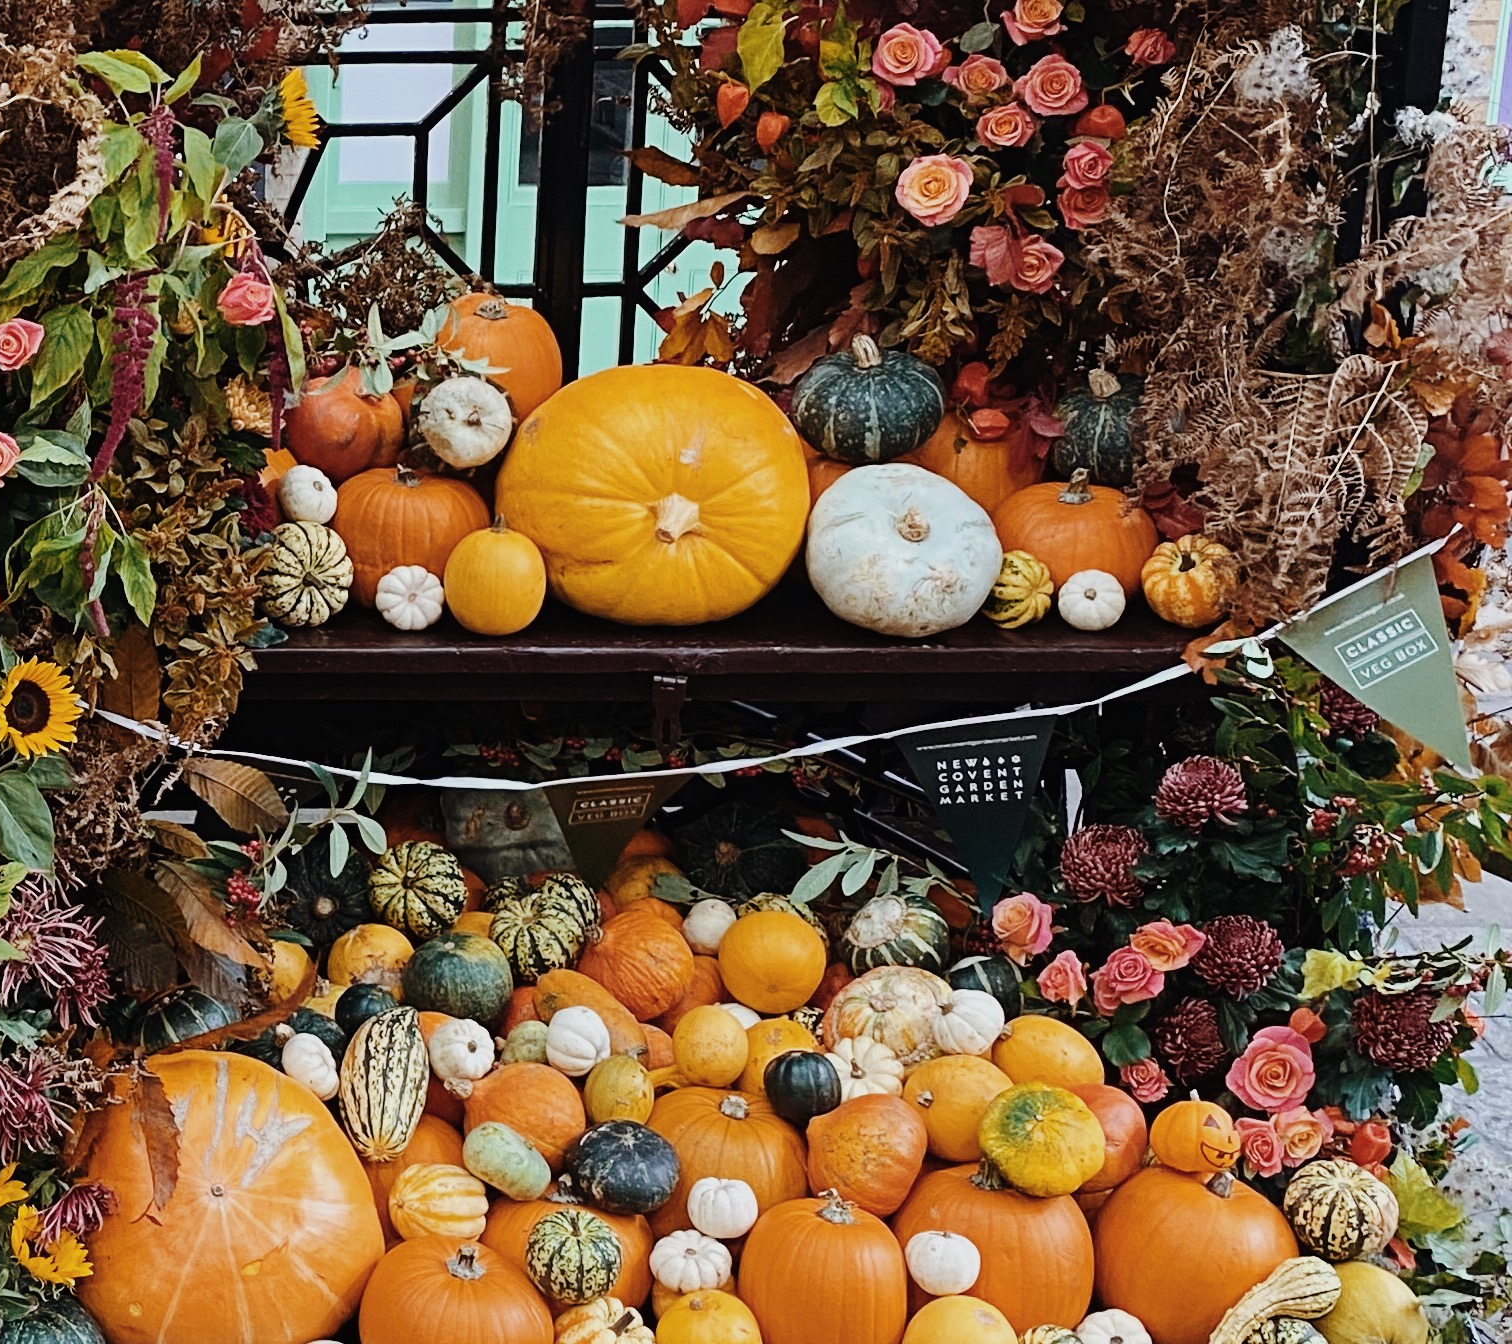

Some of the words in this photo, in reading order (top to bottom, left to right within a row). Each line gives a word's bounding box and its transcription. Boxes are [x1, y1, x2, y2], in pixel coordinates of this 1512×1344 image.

[1346, 618, 1414, 658] CLASSIC
[1360, 657, 1393, 679] VEG
[1394, 639, 1428, 662] BOX
[937, 758, 977, 771] NEW
[938, 767, 1021, 782] COVENT
[939, 779, 1024, 794] GARDEN
[939, 790, 1024, 805] MARKET
